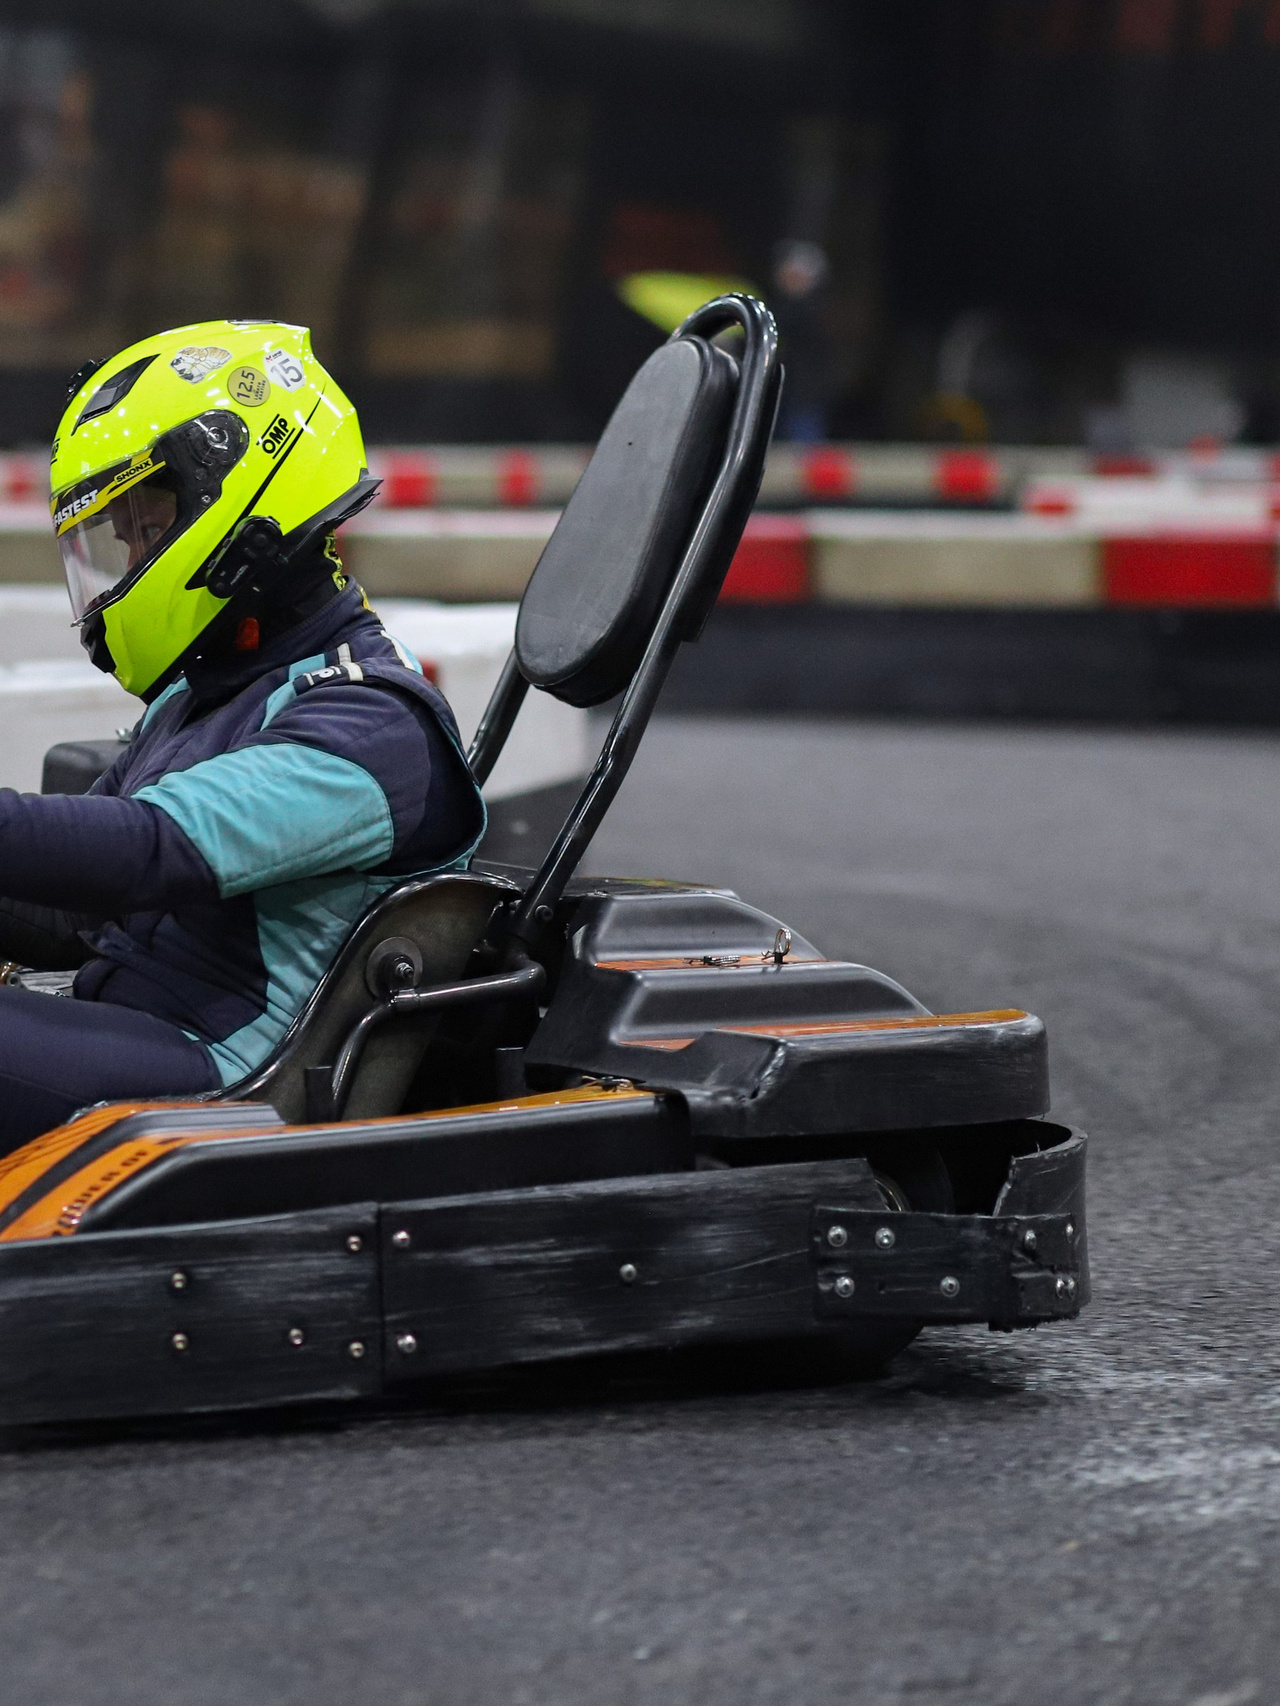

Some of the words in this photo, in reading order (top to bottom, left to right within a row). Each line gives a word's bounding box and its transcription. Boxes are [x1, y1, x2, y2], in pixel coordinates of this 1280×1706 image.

[236, 370, 256, 399] 12.5
[270, 358, 303, 388] 15
[262, 418, 289, 454] OMP
[116, 460, 151, 482] SHONX
